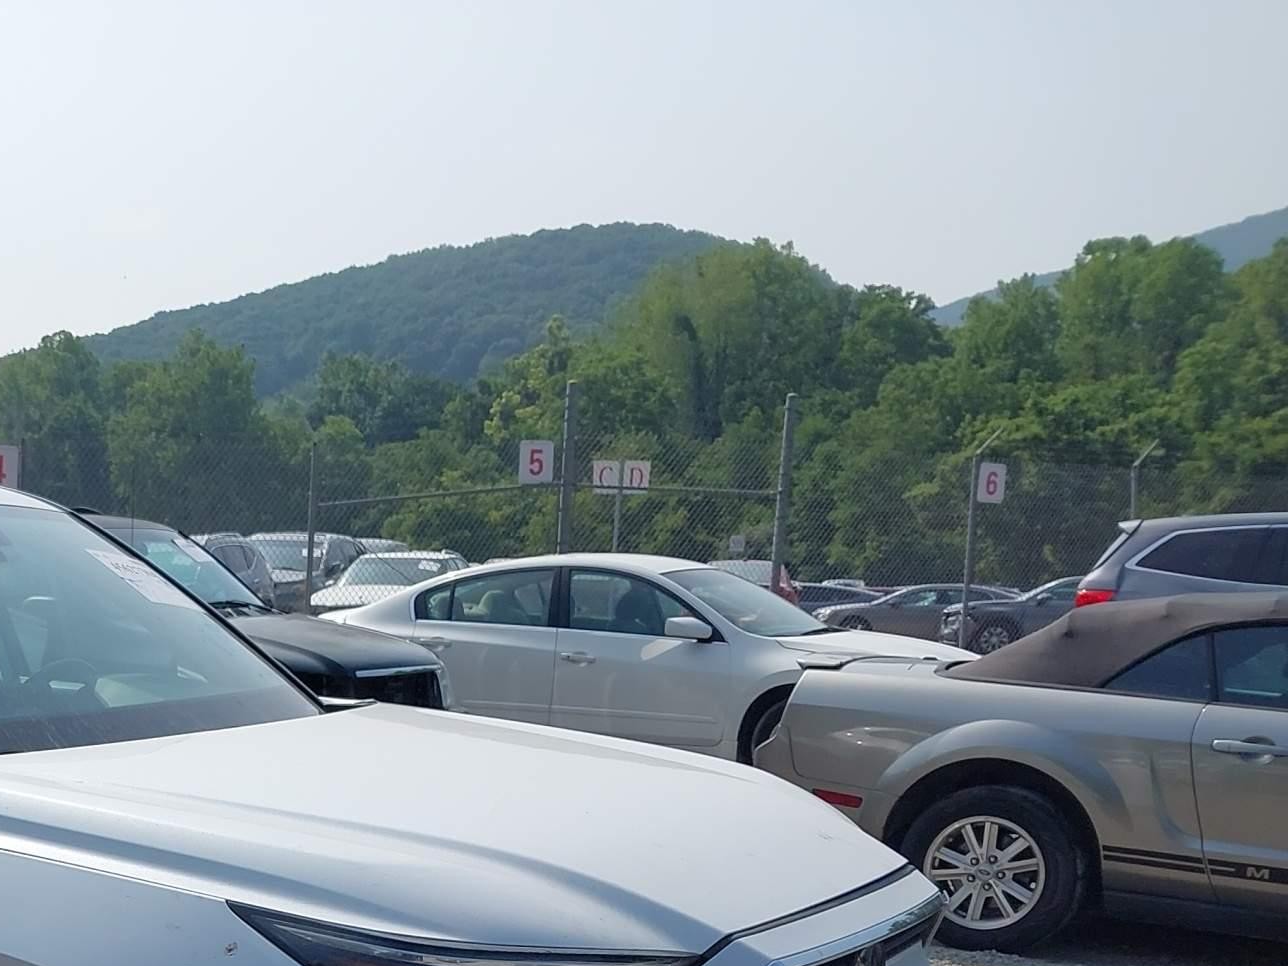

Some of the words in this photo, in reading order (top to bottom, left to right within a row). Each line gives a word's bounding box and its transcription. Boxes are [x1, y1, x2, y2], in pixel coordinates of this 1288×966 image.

[529, 449, 543, 475] 5
[599, 466, 613, 487] C
[630, 467, 643, 487] D
[986, 471, 998, 496] 6
[1246, 867, 1270, 879] M
